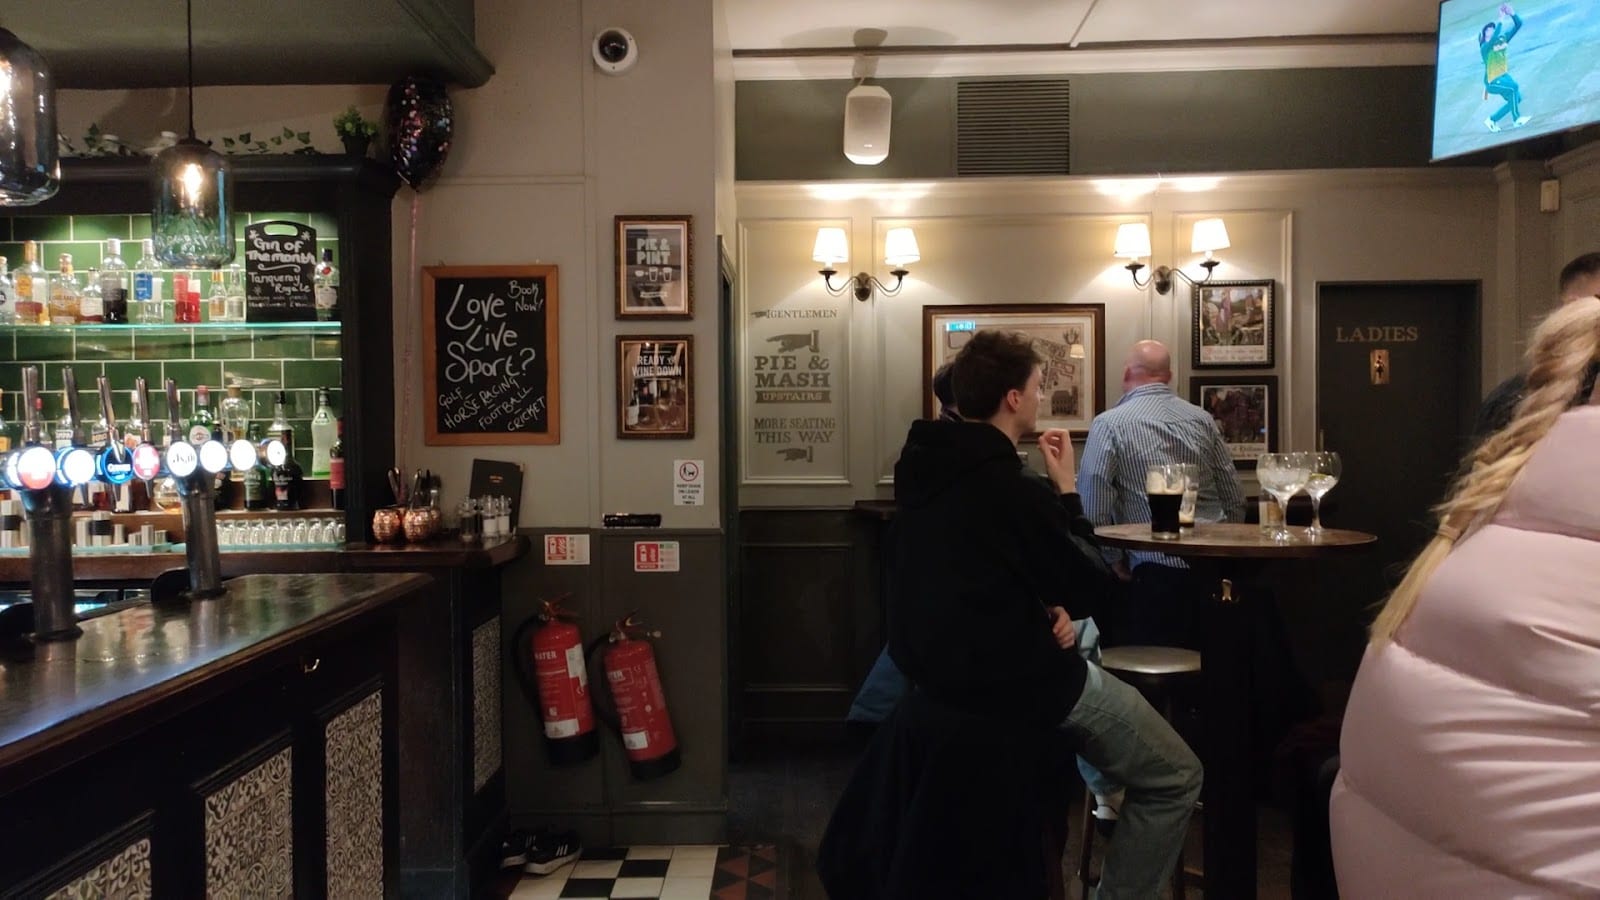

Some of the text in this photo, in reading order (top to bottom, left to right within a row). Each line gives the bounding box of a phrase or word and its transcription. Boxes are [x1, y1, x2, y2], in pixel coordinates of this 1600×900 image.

[254, 238, 304, 252] Gin of
[637, 238, 670, 250] PIE &
[637, 251, 670, 265] PINT
[248, 272, 300, 287] Tanqueray
[507, 280, 539, 305] Book
[445, 284, 507, 330] Love
[515, 296, 544, 313] Now!
[769, 309, 837, 319] GENTLEMEN
[466, 322, 518, 351] Live
[1336, 326, 1418, 342] LADIES
[445, 341, 536, 384] Sport?
[638, 355, 664, 365] READY
[754, 355, 830, 371] PIE &
[632, 366, 682, 377] WINE DOWN
[755, 372, 831, 388] MASH
[439, 387, 464, 409] GOLF
[444, 376, 520, 429] HORSE RACING
[762, 392, 823, 401] UPSTAIRS
[479, 387, 534, 430] FOOTBALL
[507, 396, 545, 432] CRICKET
[754, 418, 835, 430] MORE SEATING
[755, 431, 835, 444] THIS WAY
